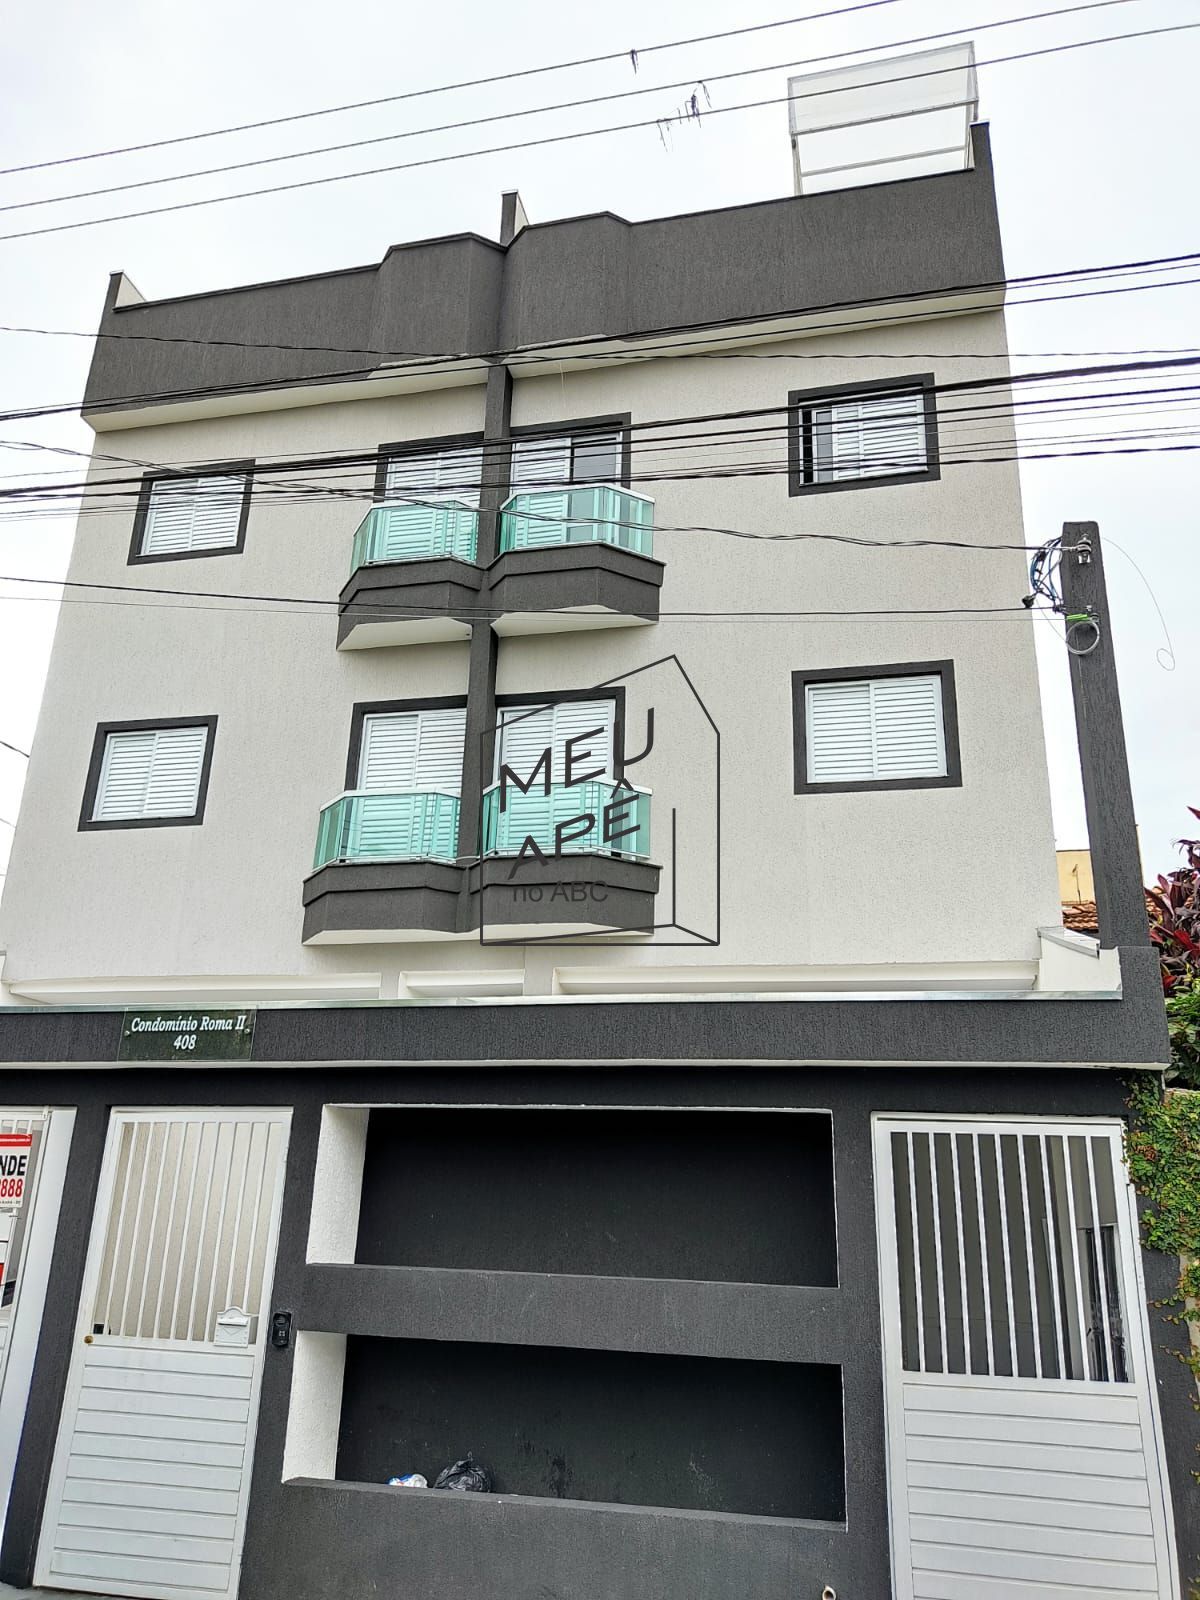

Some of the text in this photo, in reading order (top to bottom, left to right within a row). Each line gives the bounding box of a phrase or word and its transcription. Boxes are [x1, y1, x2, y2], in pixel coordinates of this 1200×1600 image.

[131, 1015, 247, 1032] Condomínio Roma II
[173, 1034, 197, 1050] 408
[0, 1178, 23, 1198] 888
